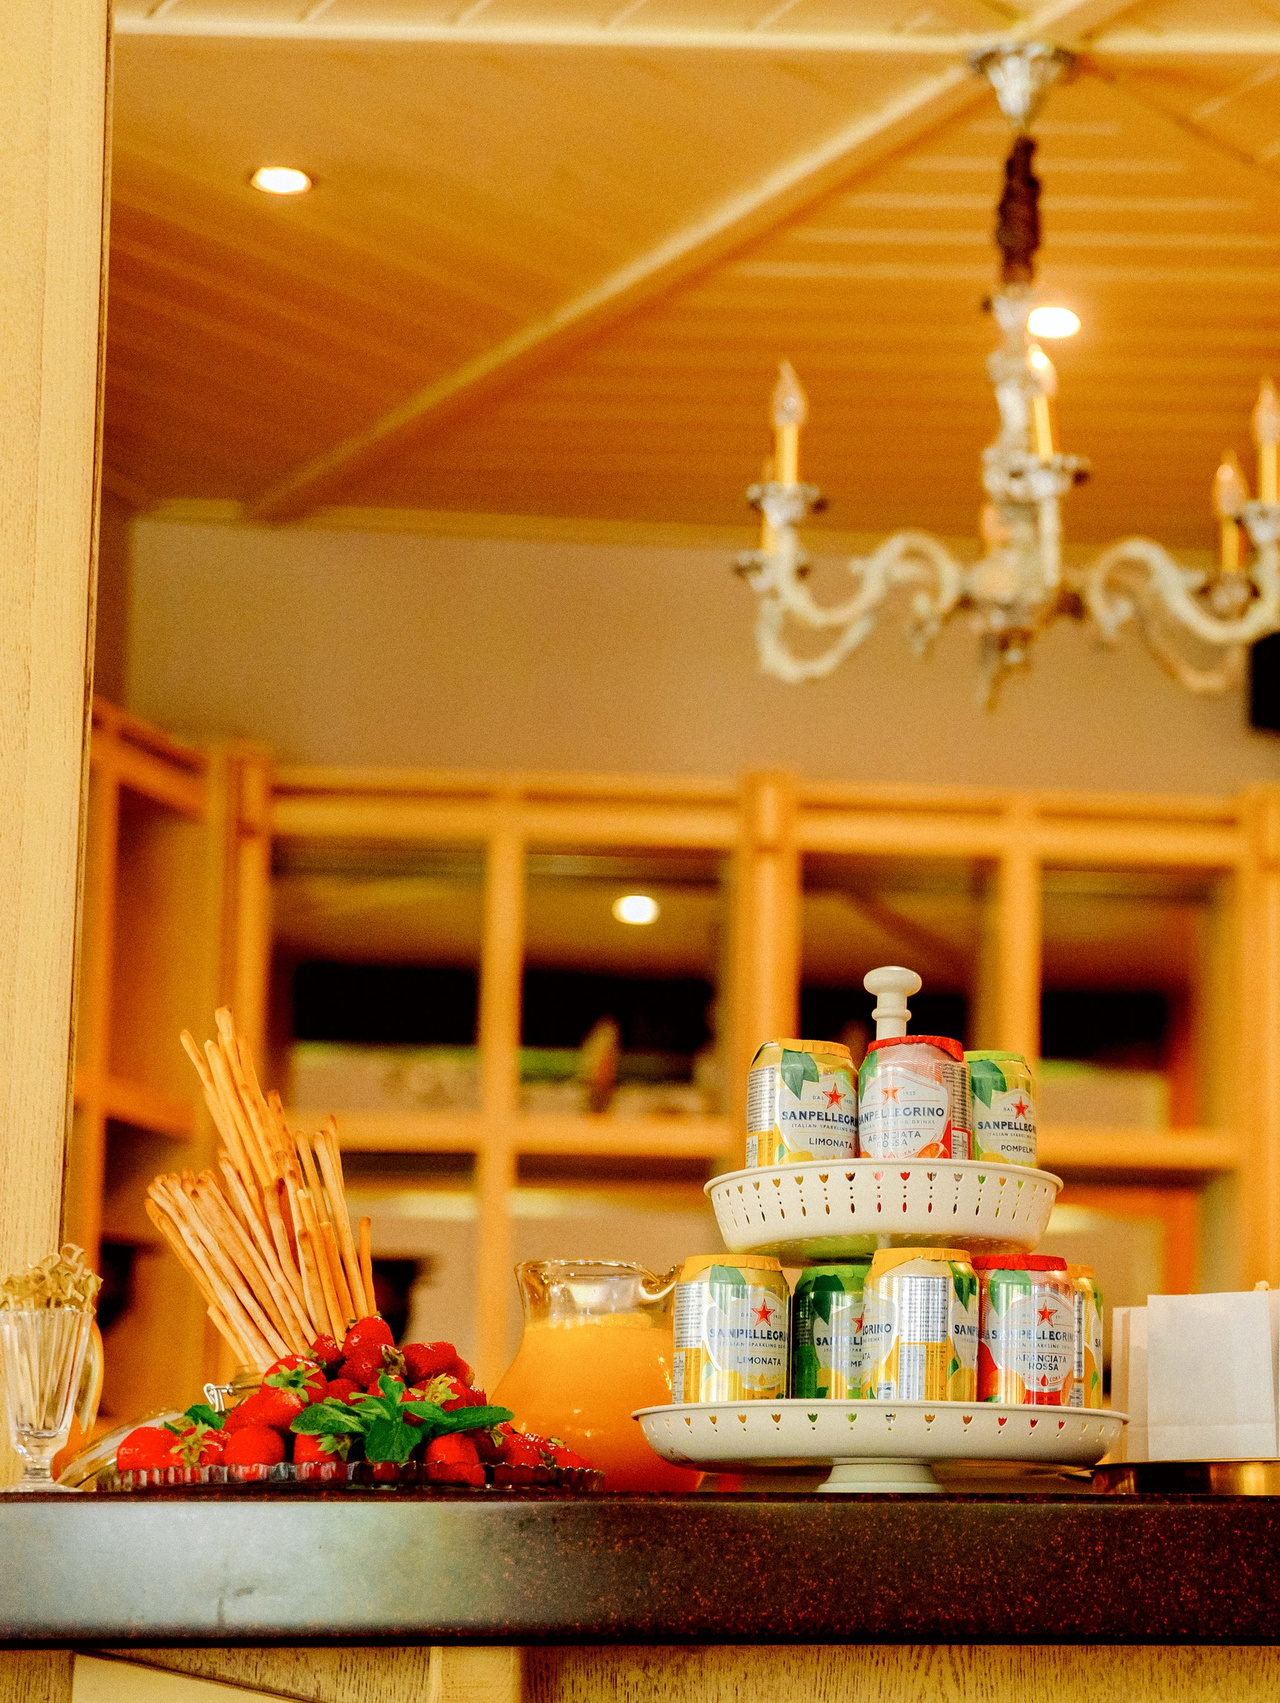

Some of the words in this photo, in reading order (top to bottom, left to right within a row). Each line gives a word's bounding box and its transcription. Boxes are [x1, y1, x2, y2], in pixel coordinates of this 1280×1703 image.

[809, 1137, 852, 1150] LIMONATA
[736, 1356, 783, 1367] LIMONATA
[1028, 1362, 1059, 1371] ROSSA
